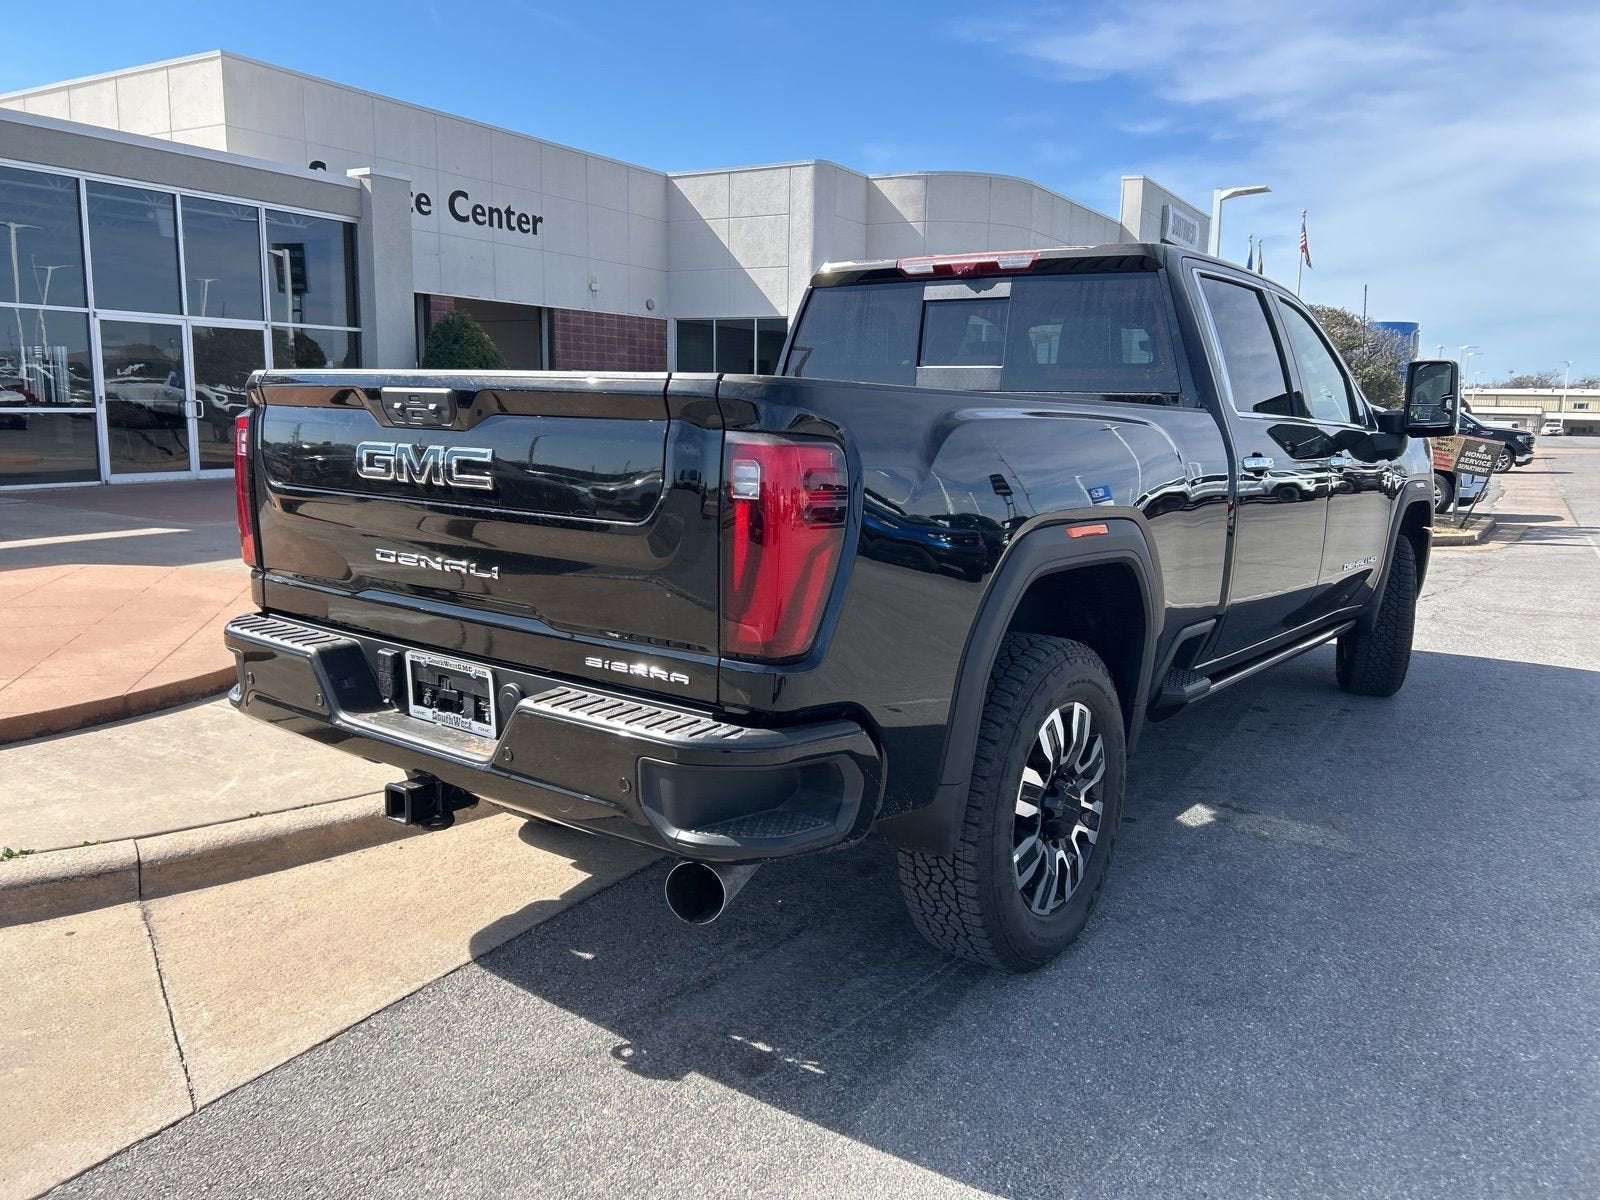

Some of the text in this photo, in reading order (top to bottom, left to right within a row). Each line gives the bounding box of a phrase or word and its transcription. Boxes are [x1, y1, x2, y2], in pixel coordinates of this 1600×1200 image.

[448, 190, 544, 236] Center
[355, 440, 495, 491] GMC
[1457, 464, 1490, 473] DEPARTMENT
[1460, 457, 1493, 468] SERVICE
[1465, 451, 1492, 460] HONDA
[375, 548, 499, 580] DENALI
[584, 656, 690, 685] SIERRA
